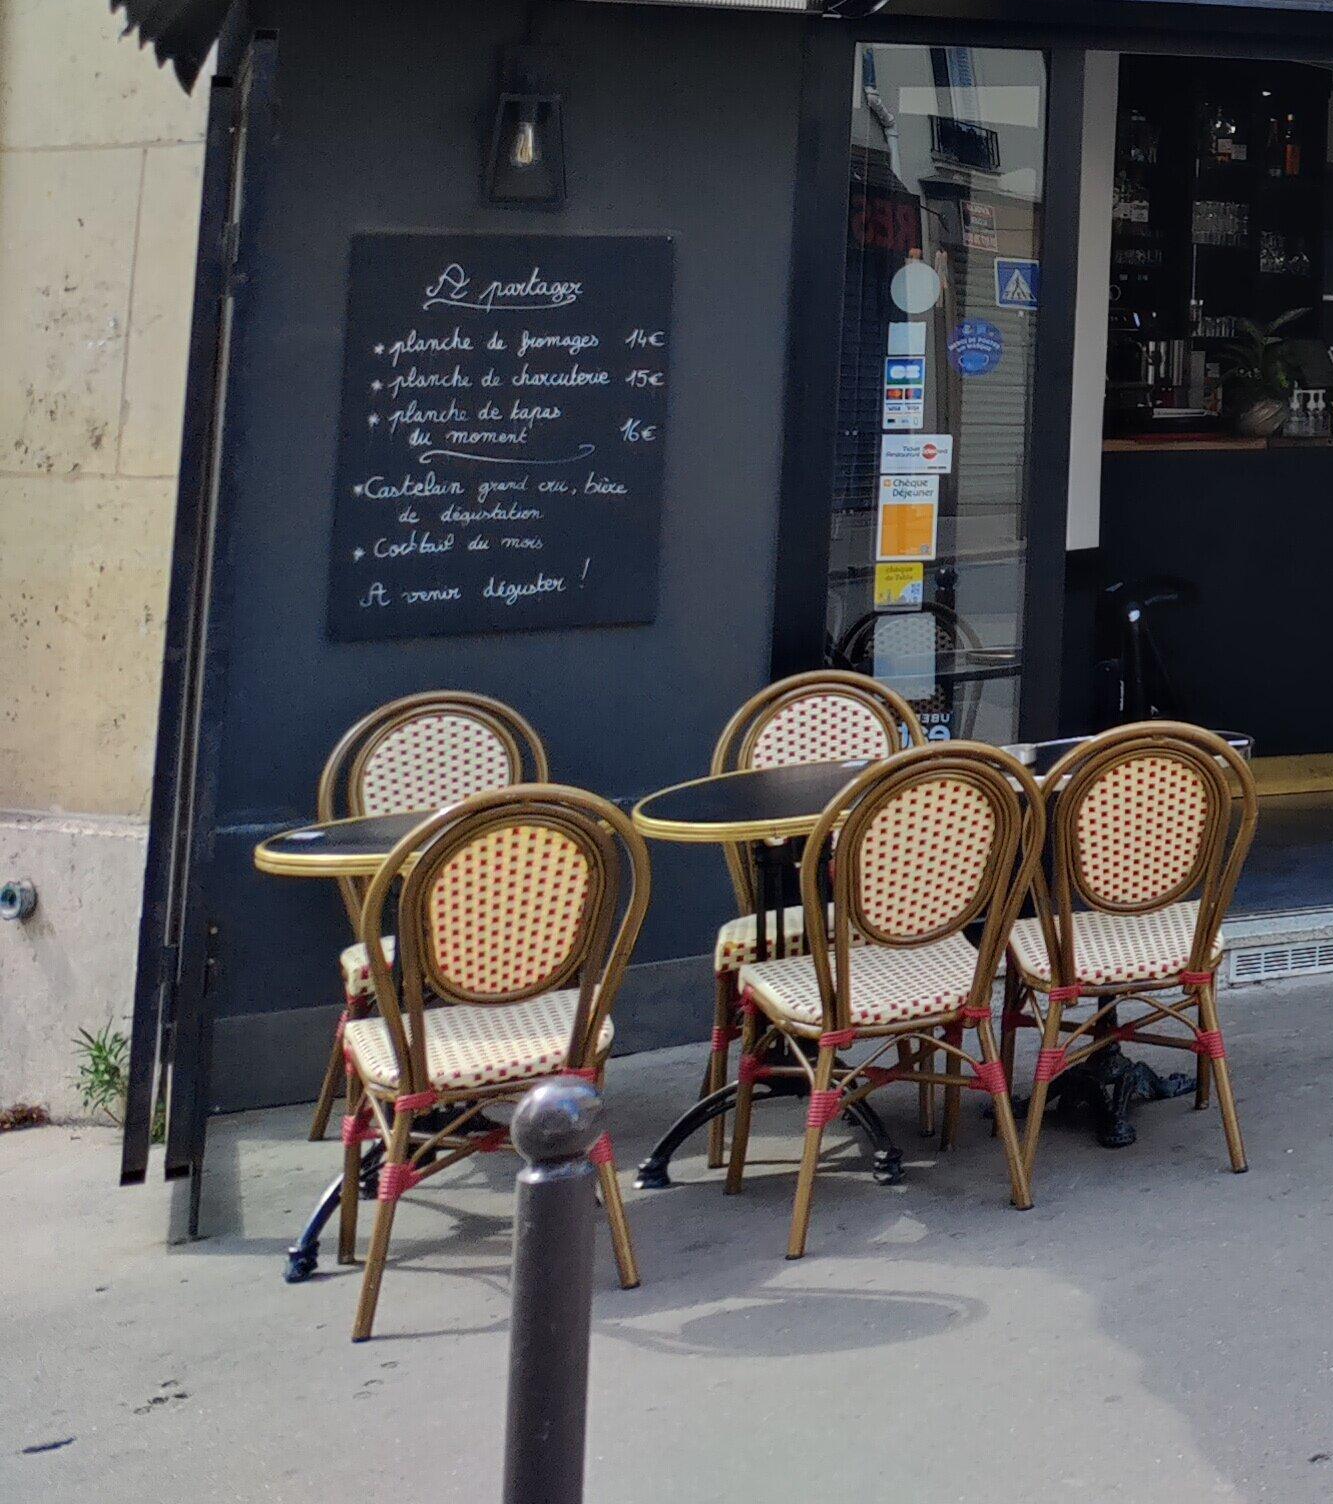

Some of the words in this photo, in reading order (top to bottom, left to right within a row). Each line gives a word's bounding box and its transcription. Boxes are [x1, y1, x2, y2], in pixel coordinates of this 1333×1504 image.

[478, 267, 584, 313] partager
[389, 326, 474, 367] planche
[486, 331, 508, 350] de
[516, 329, 600, 358] fromages
[624, 328, 665, 348] 14€
[389, 364, 473, 398] planche
[481, 367, 503, 388] de
[512, 363, 611, 388] charcuterie
[625, 368, 665, 388] 15€
[388, 399, 468, 434] planche
[478, 400, 503, 421] de
[510, 399, 561, 428] tapas
[409, 426, 433, 446] du
[446, 427, 528, 444] moment
[619, 417, 657, 442] 16€
[363, 470, 465, 497] Castelain
[478, 475, 528, 503] grand
[892, 488, 935, 500] Déjeuner
[399, 505, 420, 523] de
[440, 502, 544, 525] dégustation
[467, 534, 490, 551] du
[500, 536, 543, 549] mois
[359, 582, 391, 608] A
[401, 586, 462, 603] venir
[482, 573, 566, 606] déguster
